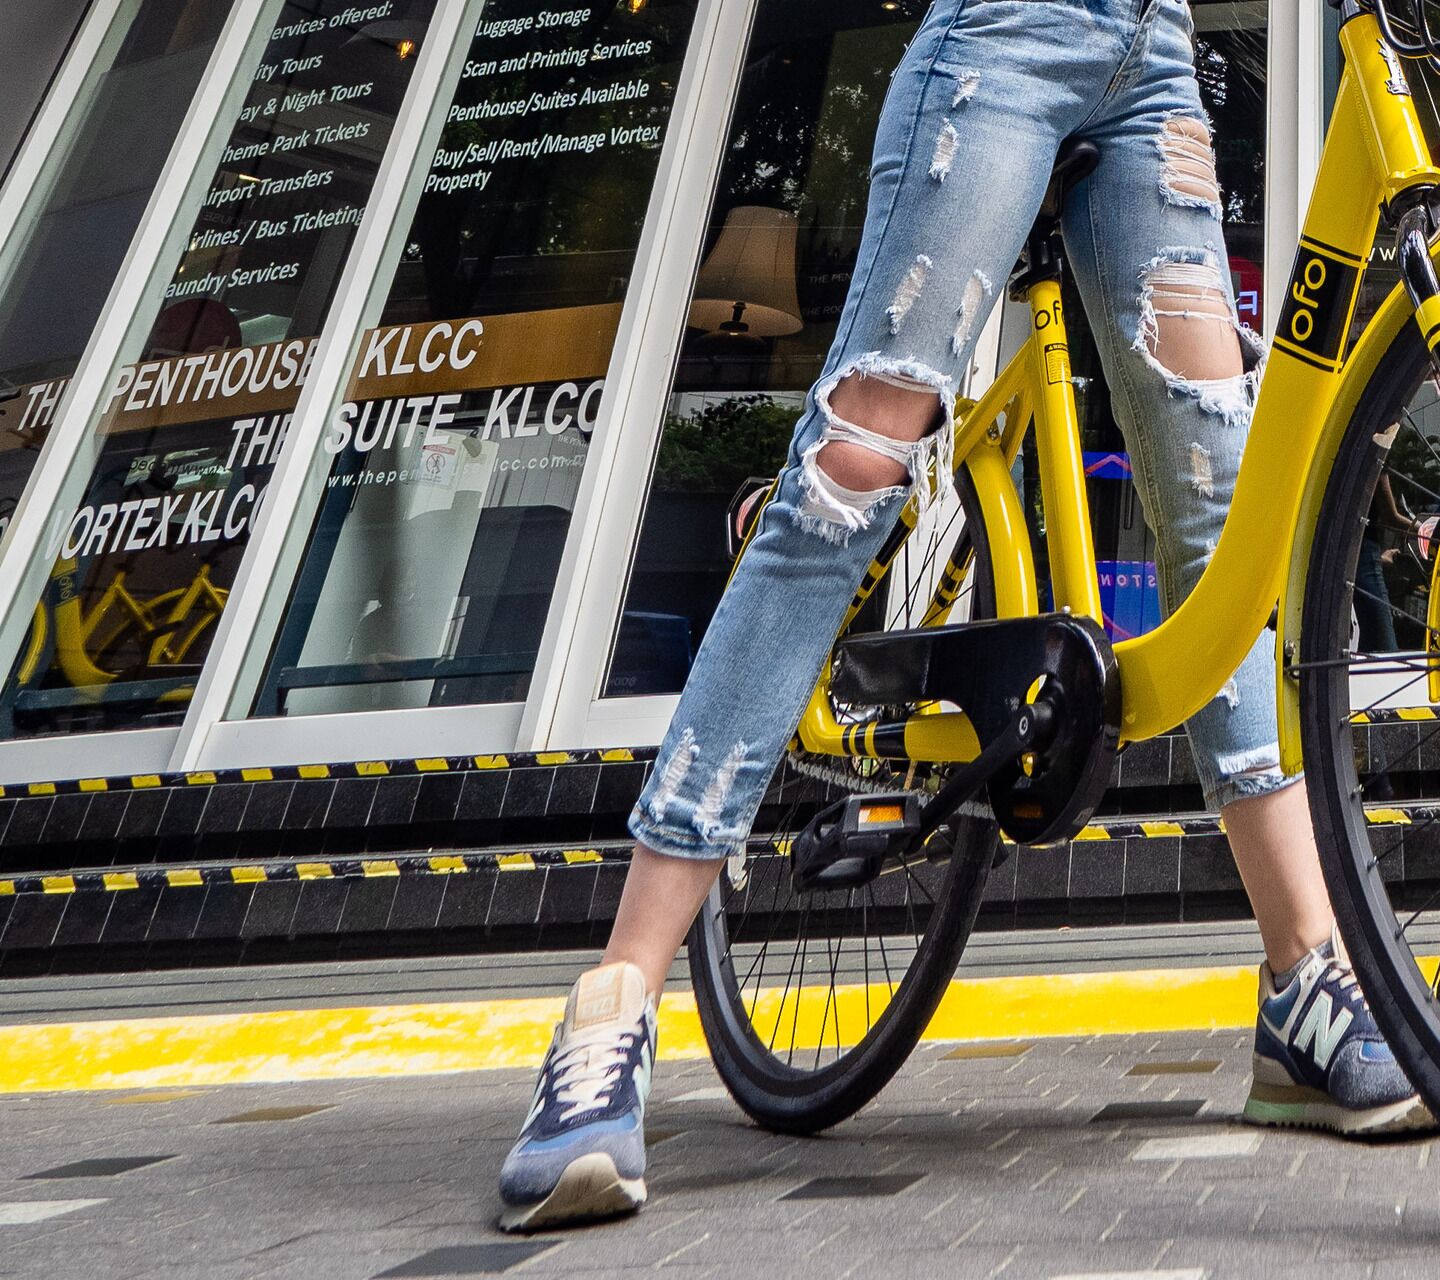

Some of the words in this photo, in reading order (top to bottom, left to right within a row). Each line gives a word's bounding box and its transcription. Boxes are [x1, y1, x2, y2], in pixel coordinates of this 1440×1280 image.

[271, 16, 326, 41] ervices
[329, 0, 394, 28] offered:
[475, 14, 533, 39] Luggage
[535, 8, 591, 30] Storage
[281, 53, 324, 76] Tours
[462, 59, 497, 79] Scan
[499, 53, 529, 74] and
[529, 46, 589, 70] Printing
[590, 38, 652, 62] Services
[263, 97, 278, 117] &
[280, 89, 327, 114] Night
[330, 80, 374, 102] Tours
[448, 90, 577, 124] Penthouse/Suites
[579, 78, 650, 107] Available
[272, 131, 311, 154] Park
[314, 121, 371, 145] Tickets
[433, 130, 606, 169] Buy/Sell/Rent/Manage
[609, 124, 661, 146] Vortex
[258, 168, 334, 197] Transfers
[424, 168, 492, 194] Property
[256, 219, 287, 241] Bus
[165, 271, 227, 298] aundry
[228, 261, 300, 288] Services
[1291, 258, 1326, 341] ofo
[101, 338, 320, 416] PENTHOUSE
[358, 319, 484, 378] KLCC
[324, 393, 462, 455] SUITE
[46, 493, 184, 561] VORTEX
